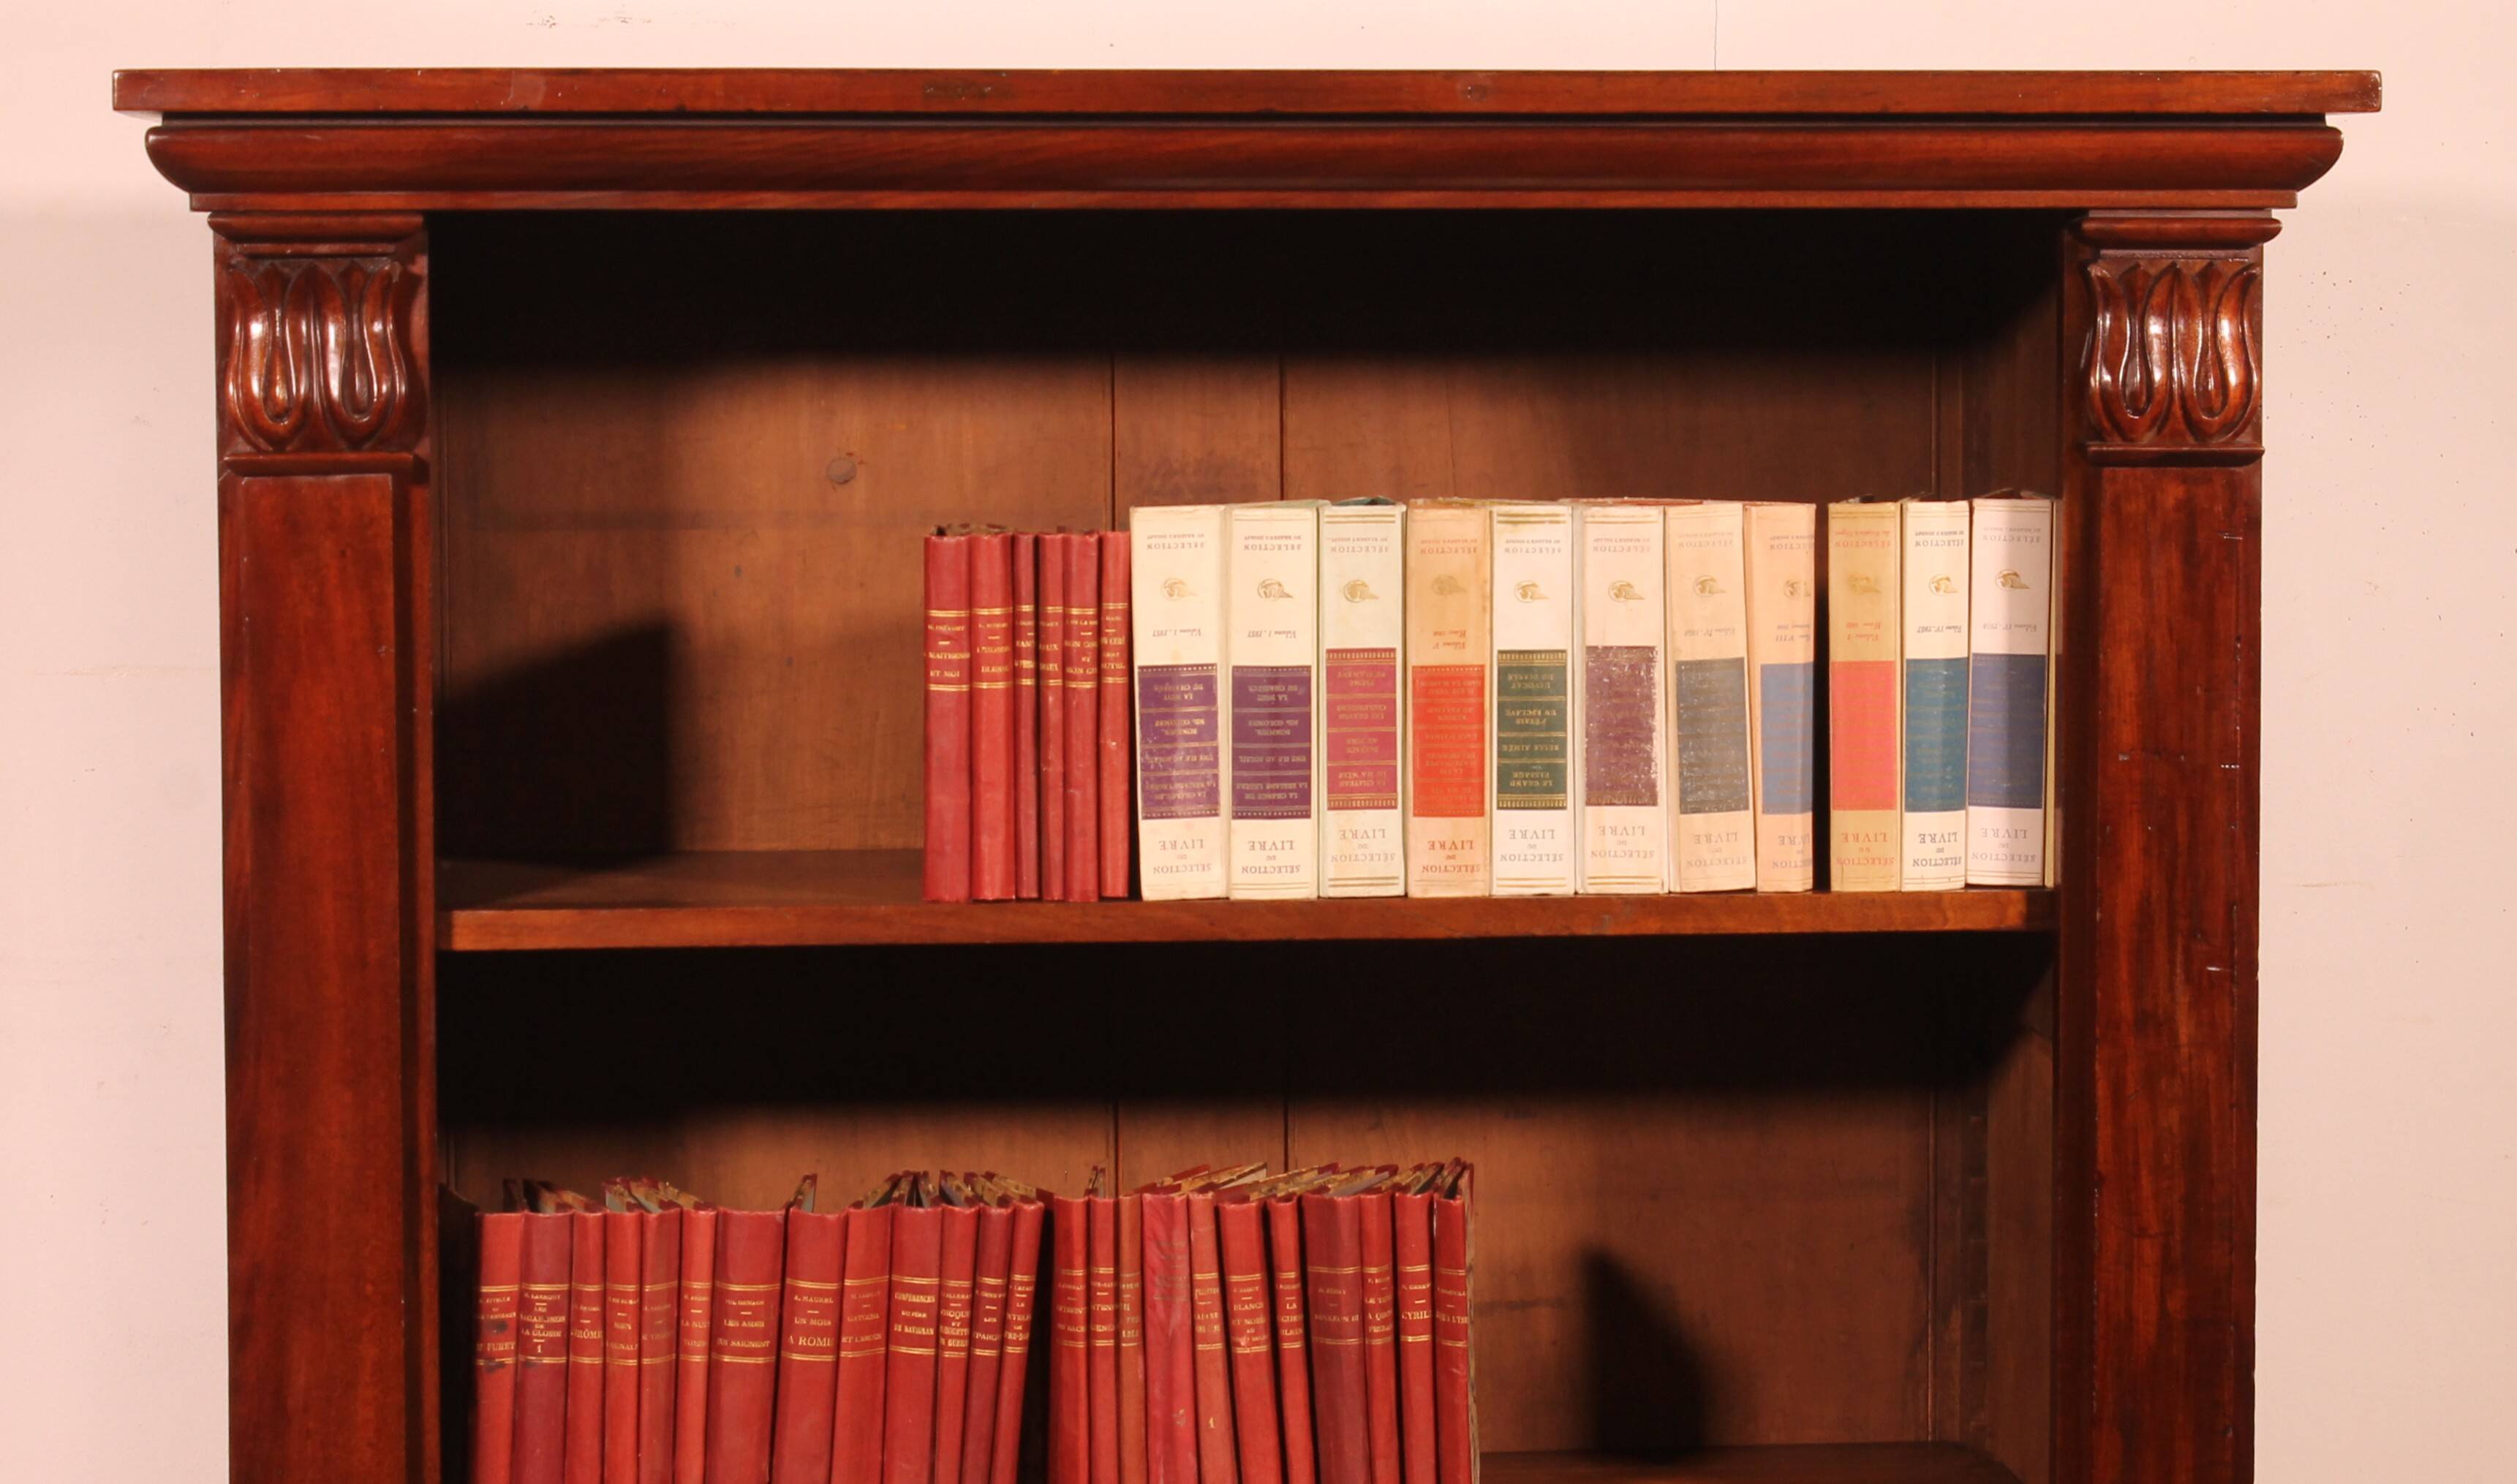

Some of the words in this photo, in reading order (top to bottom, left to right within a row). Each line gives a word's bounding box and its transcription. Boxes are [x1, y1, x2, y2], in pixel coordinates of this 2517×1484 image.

[1275, 630, 1297, 639] Volume
[1339, 828, 1386, 840] LIVRE
[1509, 829, 1555, 840] LIVRE
[1599, 825, 1645, 836] LIVRE
[1980, 828, 2027, 839] LIVRE
[1694, 833, 1737, 844] LIVRE
[1841, 833, 1887, 843] LIVRE
[1919, 832, 1958, 844] LIVRE
[1158, 839, 1204, 850] LIVRE
[1248, 841, 1294, 851] LIVRE
[1427, 840, 1473, 850] LIVRE
[1331, 853, 1395, 863] SÉLECTION
[1500, 854, 1564, 863] SÉLECTION
[1590, 849, 1655, 860] SÉLECTION
[1971, 852, 2036, 863] SÉLECTION
[1836, 857, 1894, 867] SÉLECTION
[1913, 857, 1962, 867] SÉLECTION
[1153, 863, 1211, 875] SÉLECTION
[1242, 865, 1300, 875] SÉLECTION
[1422, 865, 1480, 874] SÉLECTION
